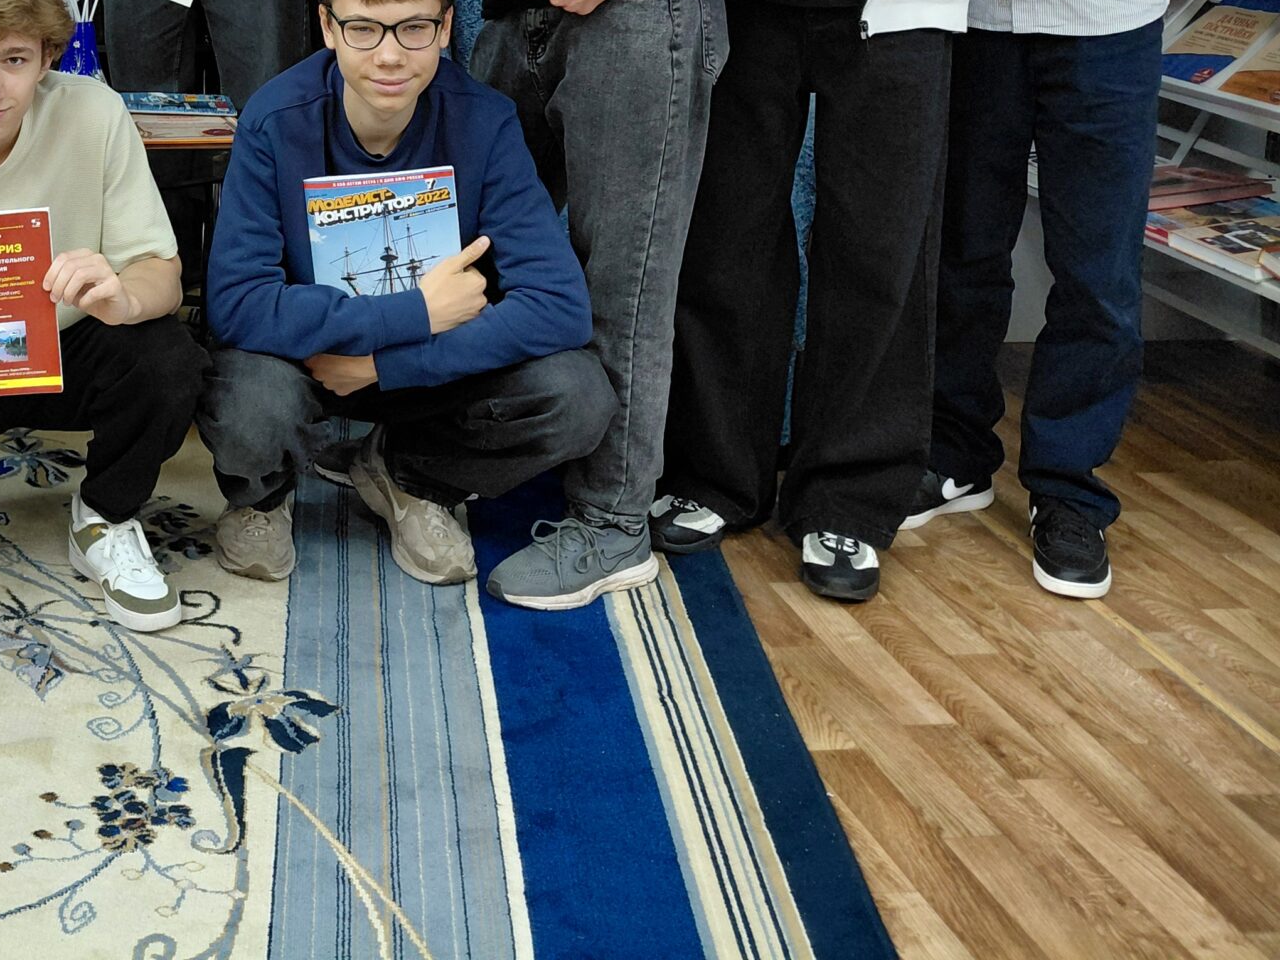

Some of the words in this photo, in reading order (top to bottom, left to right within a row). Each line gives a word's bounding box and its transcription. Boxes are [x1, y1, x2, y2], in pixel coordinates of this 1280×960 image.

[424, 178, 436, 190] 7
[416, 188, 450, 206] 2022
[314, 195, 416, 226] КОНСТРУКТОР
